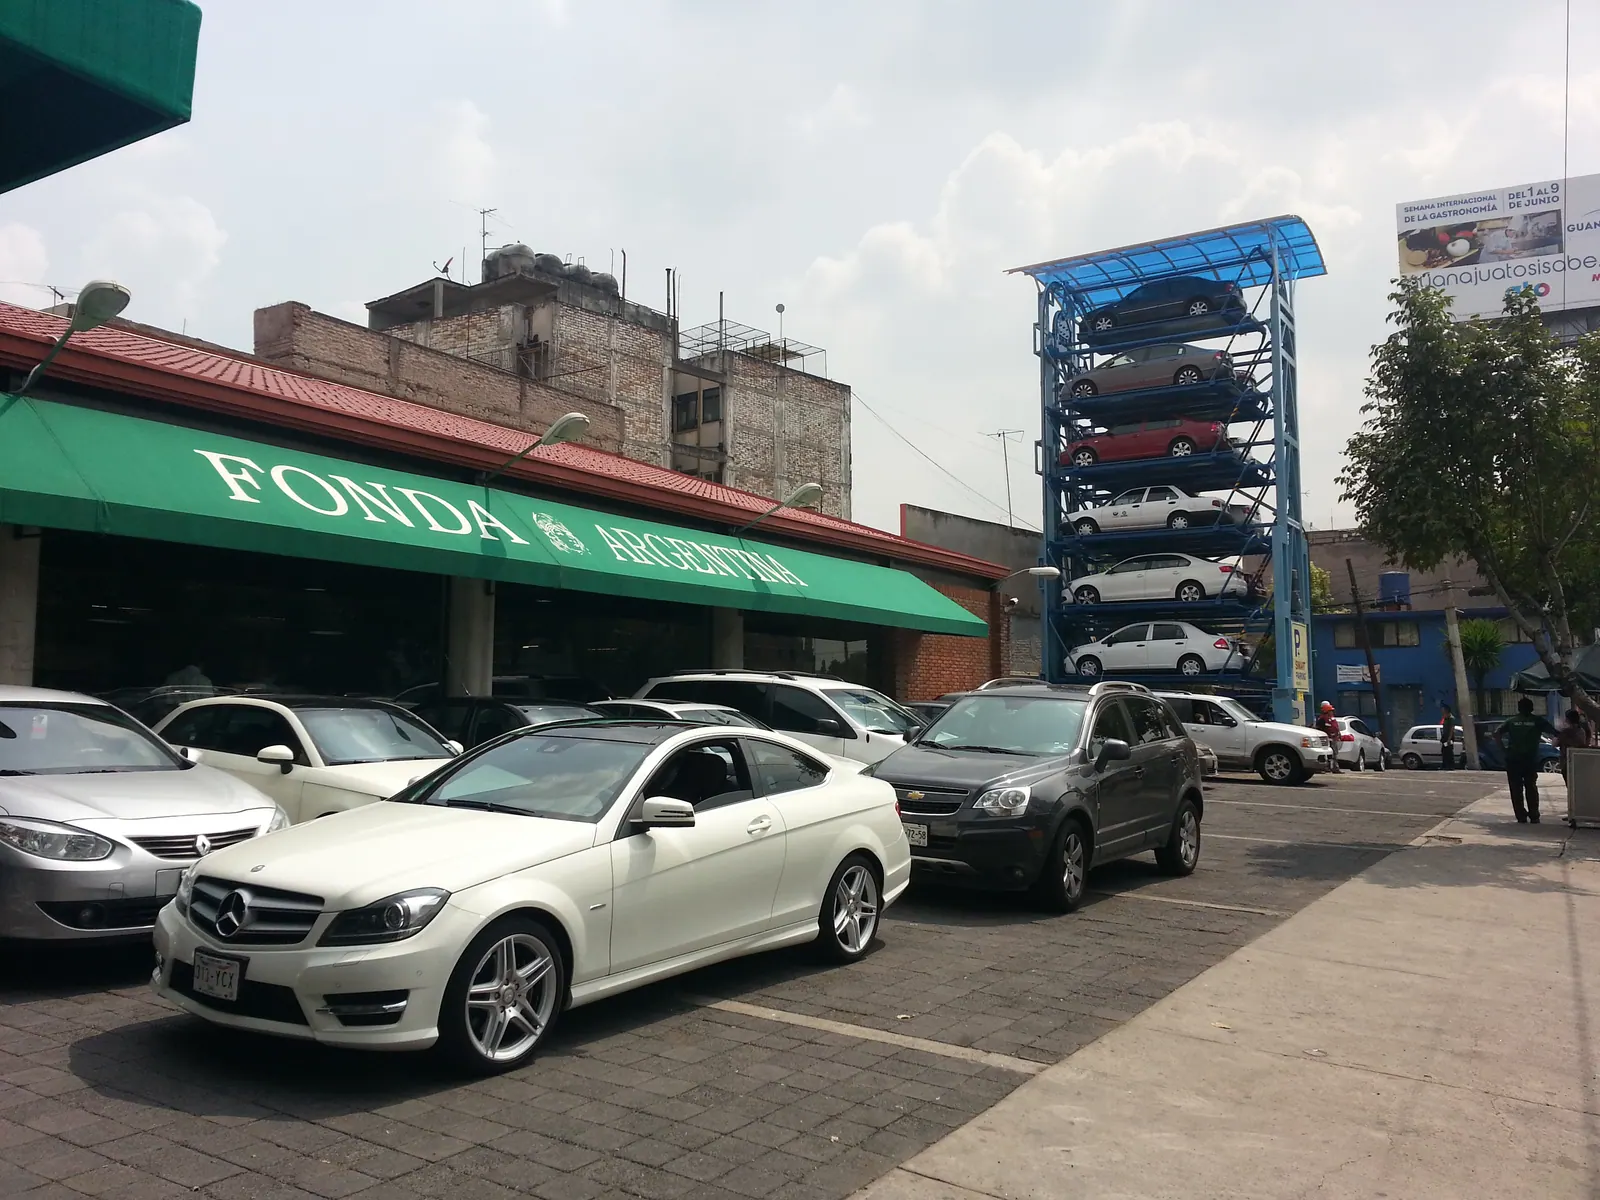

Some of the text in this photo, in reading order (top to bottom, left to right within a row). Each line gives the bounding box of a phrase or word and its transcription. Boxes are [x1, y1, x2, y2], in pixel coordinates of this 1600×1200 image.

[1508, 183, 1560, 200] DEL 1 AL 9
[1404, 194, 1497, 213] SEMANA INTERNACIONAL
[1508, 195, 1560, 209] DE JUNIO
[1404, 203, 1498, 224] DE LA GASTRONOMÍA
[193, 449, 809, 587] FONDA ARGENTINA
